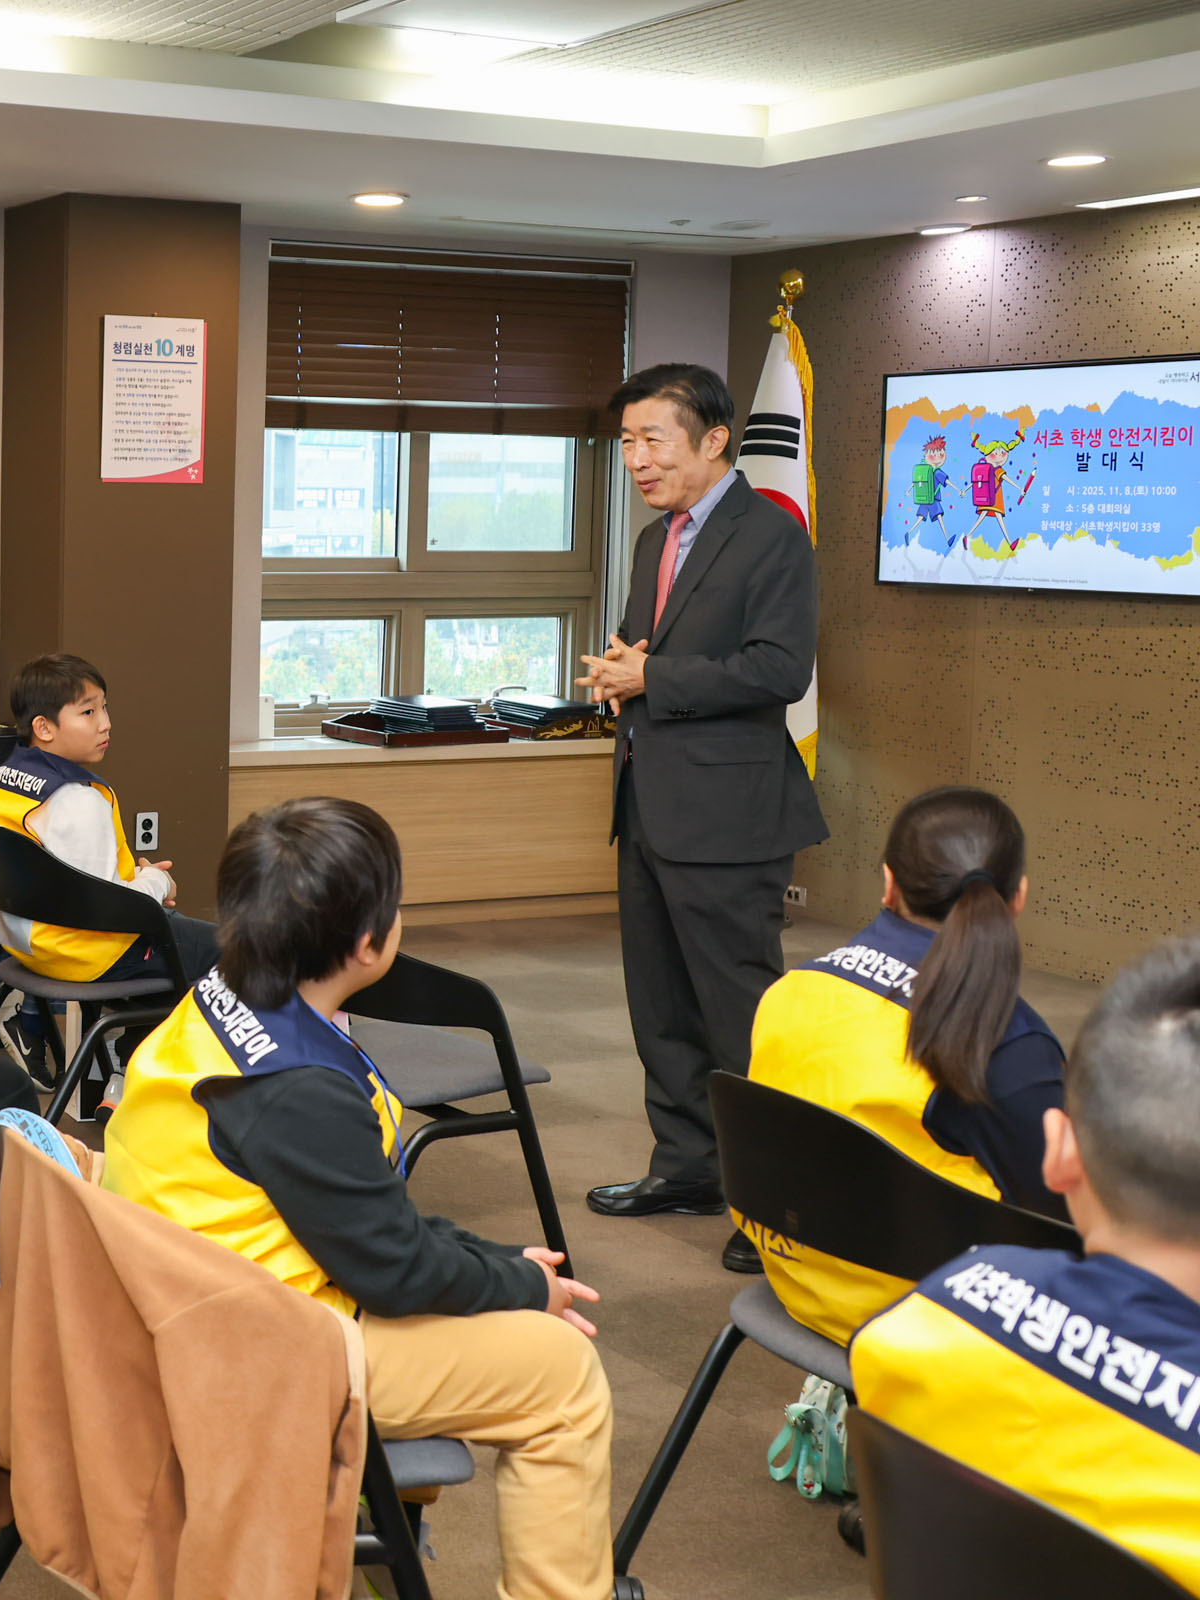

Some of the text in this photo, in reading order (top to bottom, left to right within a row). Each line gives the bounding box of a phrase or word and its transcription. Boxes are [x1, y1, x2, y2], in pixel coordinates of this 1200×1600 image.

[113, 341, 153, 356] 청렴실천
[155, 338, 174, 357] 10
[1033, 425, 1193, 448] 서초 학생 안전지킴이
[1152, 486, 1177, 496] 10:00
[1082, 504, 1095, 514] 5층
[1097, 504, 1131, 514] 대회의실
[1080, 521, 1138, 532] 서초학생지킴이
[1141, 522, 1161, 533] 33명
[943, 1262, 1200, 1437] 서초학생안전지
